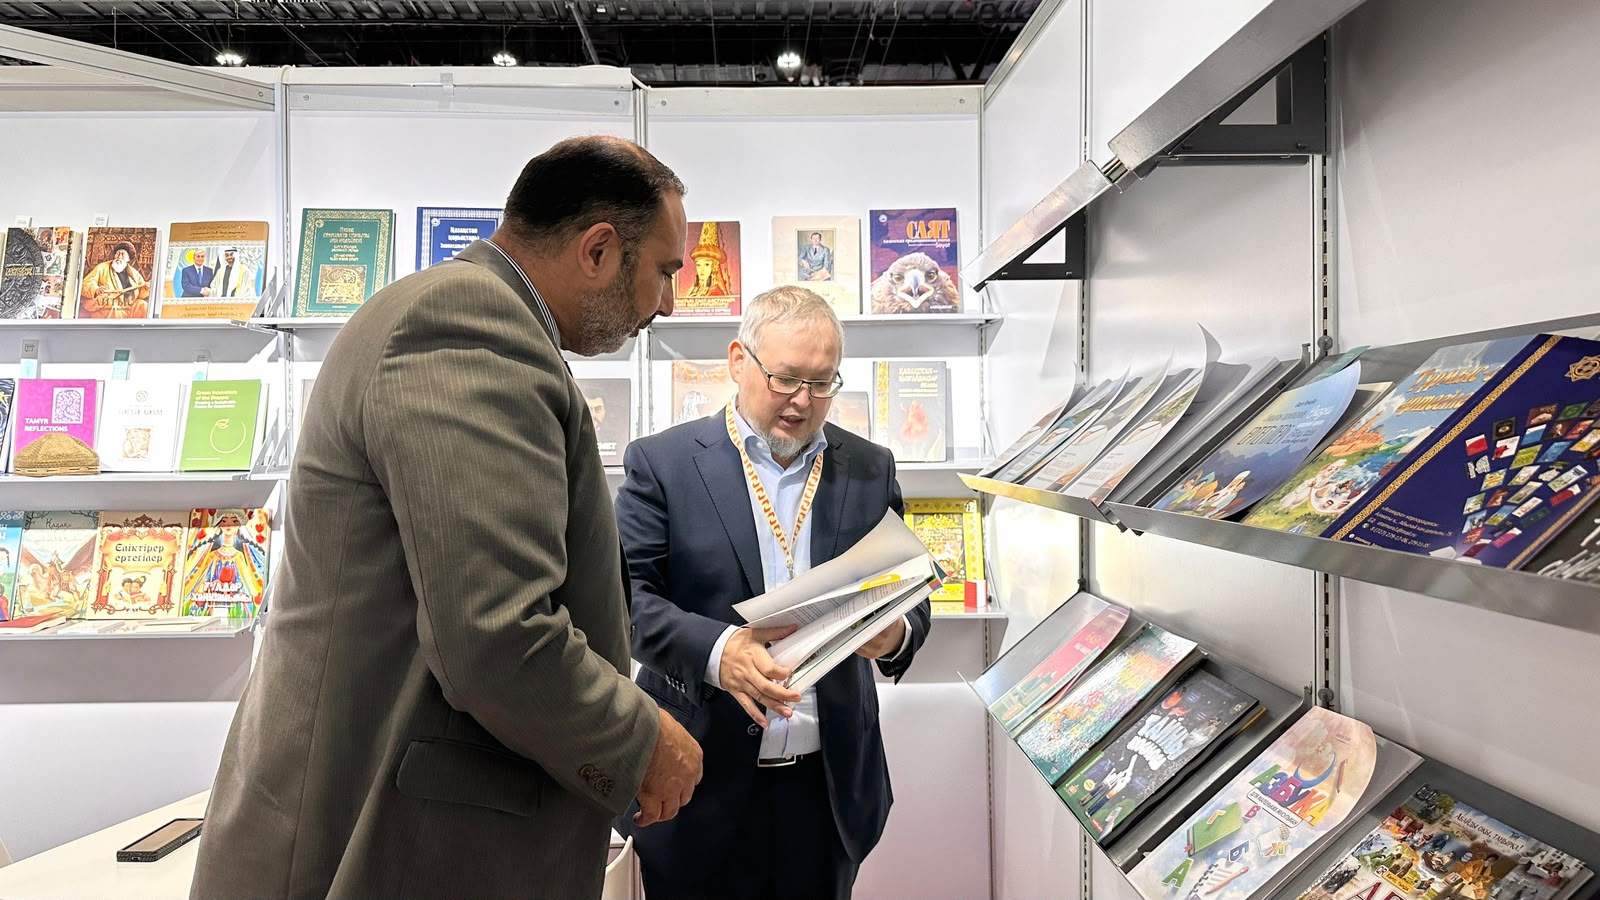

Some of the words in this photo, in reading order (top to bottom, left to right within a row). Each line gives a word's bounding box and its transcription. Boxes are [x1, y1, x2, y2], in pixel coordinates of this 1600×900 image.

[906, 220, 951, 239] САЯТ
[115, 554, 163, 563] ертегілер
[1249, 763, 1331, 827] АЗБУКА
